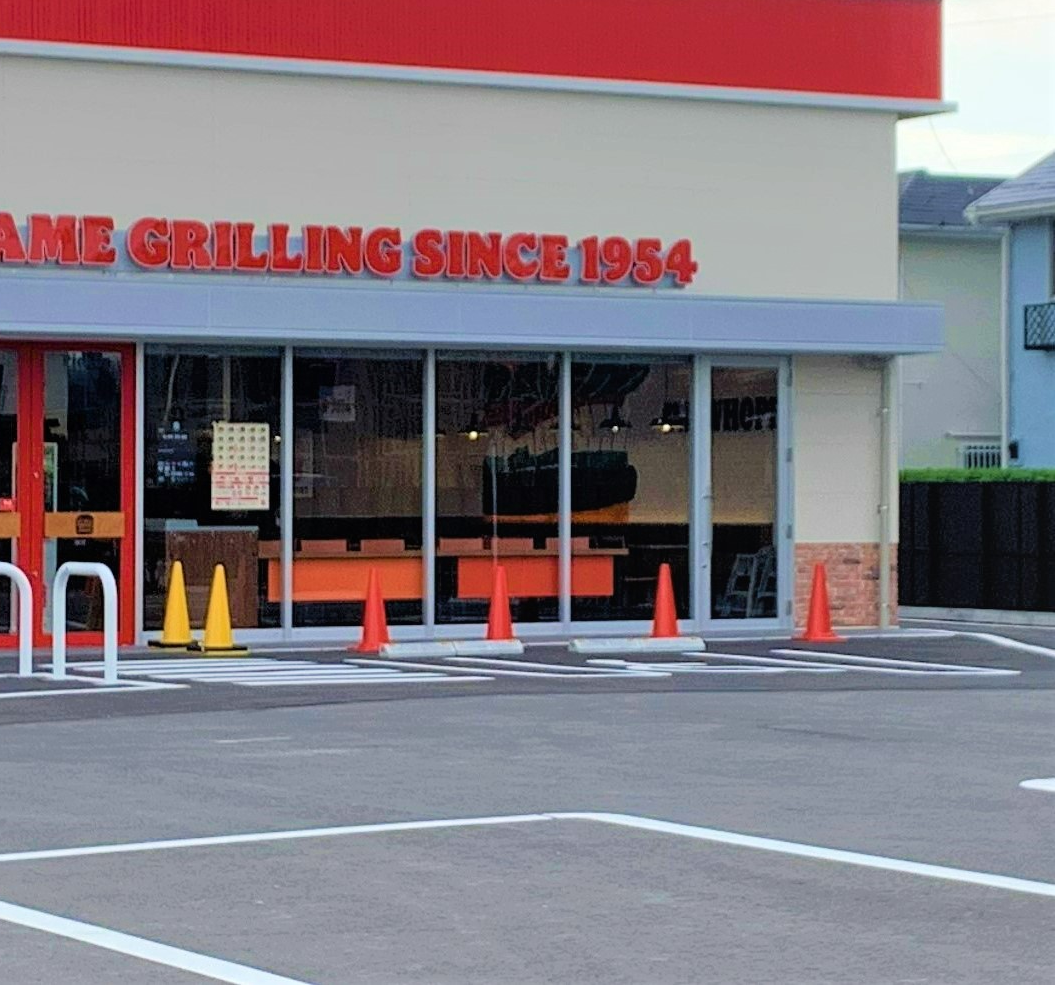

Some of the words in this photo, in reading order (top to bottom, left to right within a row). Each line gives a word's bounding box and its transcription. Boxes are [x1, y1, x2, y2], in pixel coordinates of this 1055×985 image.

[126, 217, 403, 276] GRILLING
[412, 228, 570, 282] SINCE
[579, 235, 698, 284] 1954
